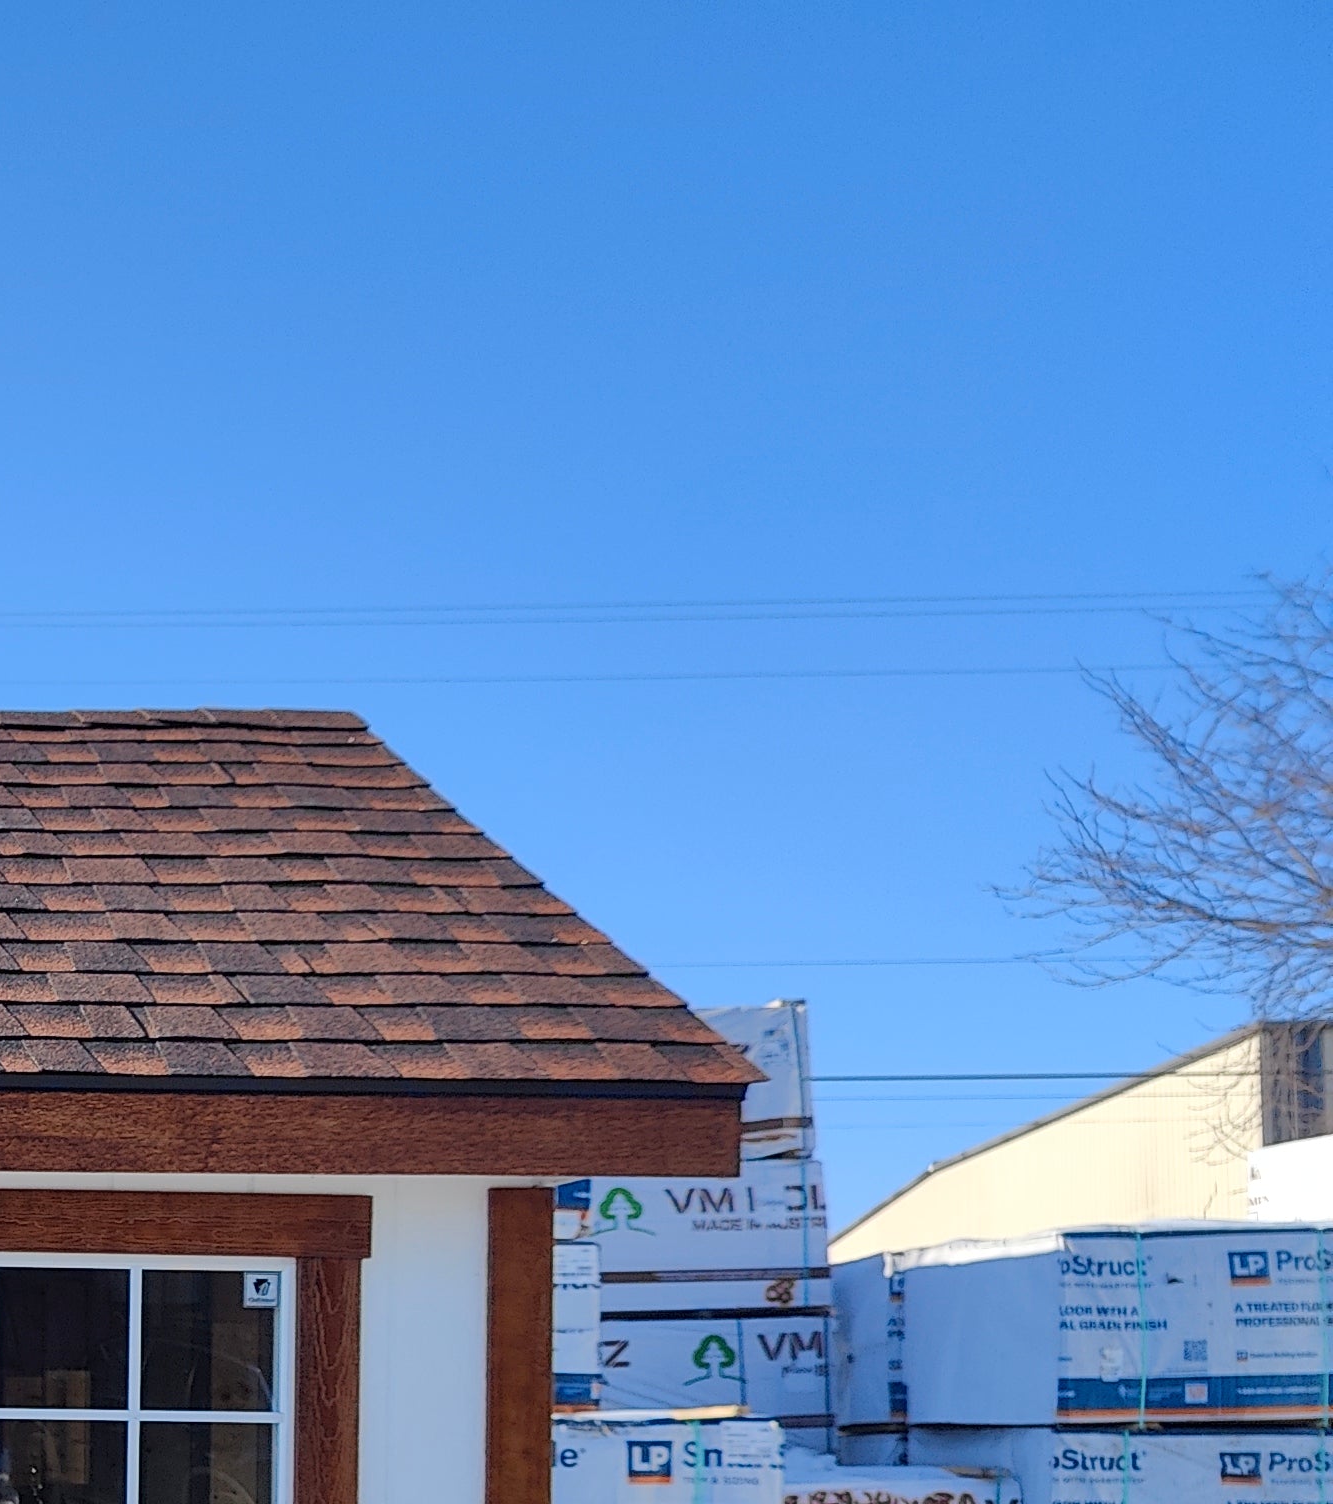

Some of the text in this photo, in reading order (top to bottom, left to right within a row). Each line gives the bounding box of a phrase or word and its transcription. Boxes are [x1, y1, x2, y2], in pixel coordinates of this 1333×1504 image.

[1232, 1253, 1267, 1277] LP
[630, 1444, 670, 1473] LP
[1221, 1453, 1258, 1476] LP
